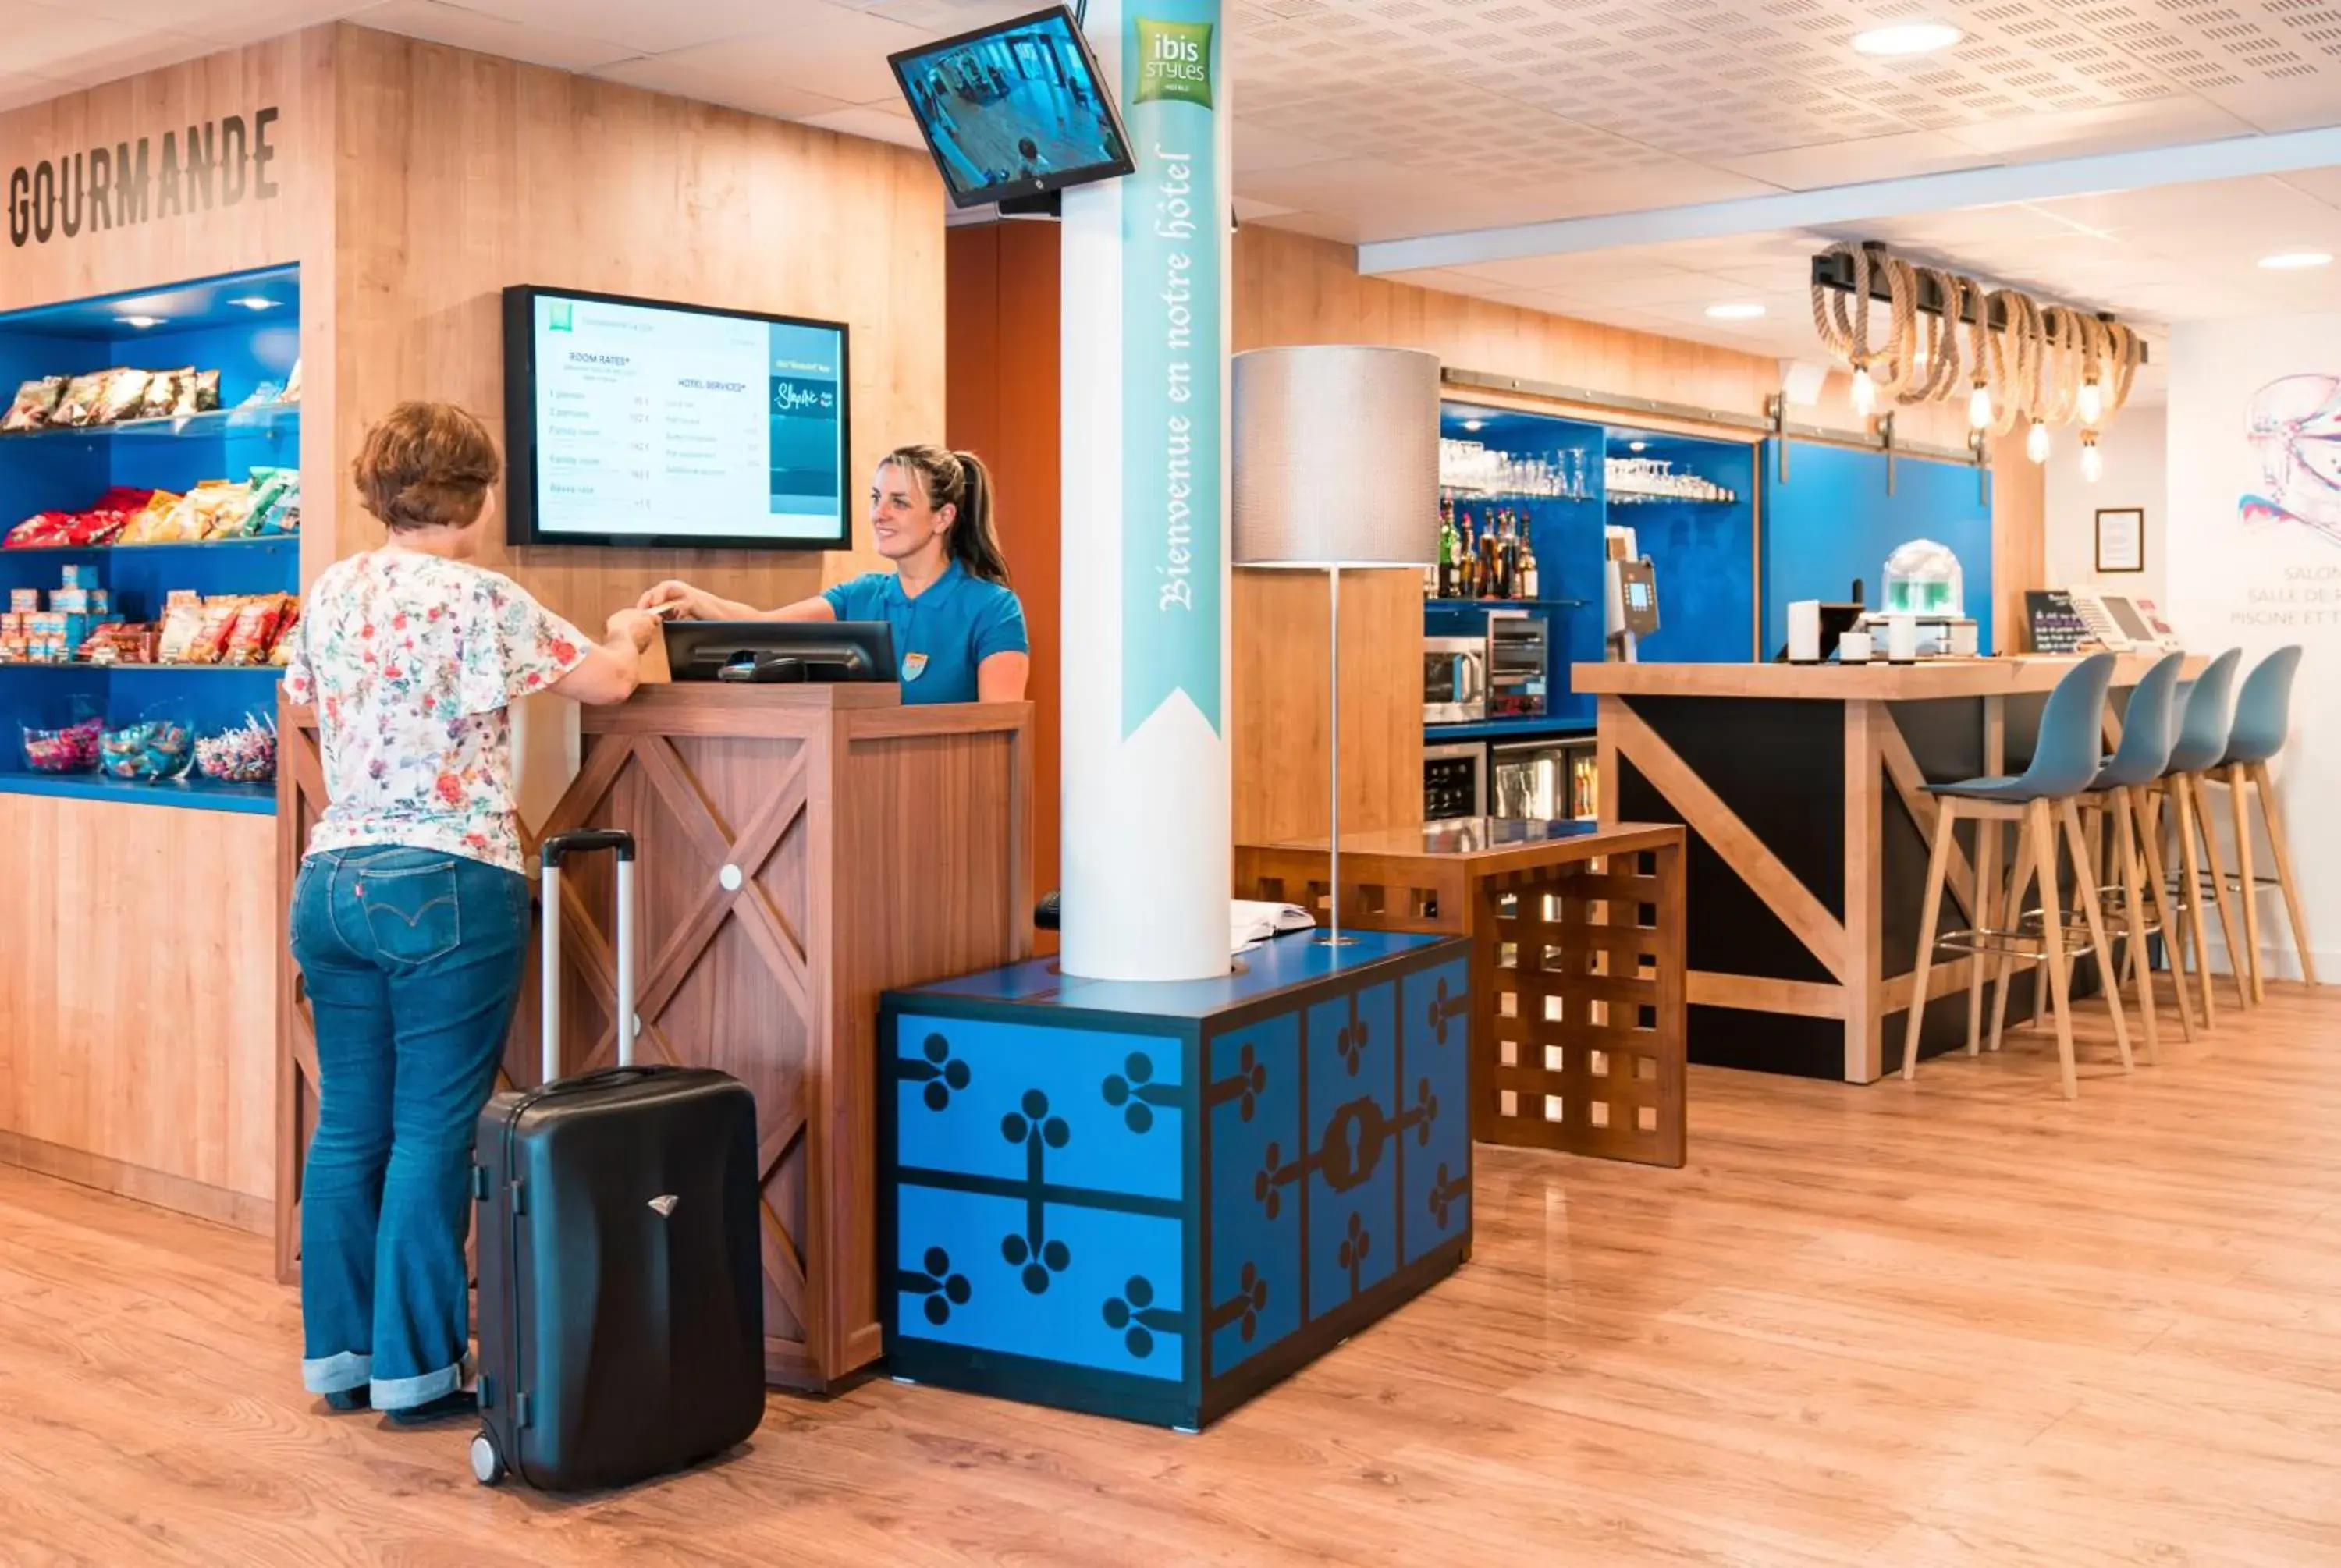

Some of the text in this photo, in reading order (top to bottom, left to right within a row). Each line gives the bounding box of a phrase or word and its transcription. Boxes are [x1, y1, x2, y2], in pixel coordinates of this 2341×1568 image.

[1155, 33, 1199, 62] ibis
[9, 106, 279, 247] GOURMANDE
[1154, 142, 1197, 612] Bienvenue en notre hôtel
[2230, 610, 2297, 626] PISCINE
